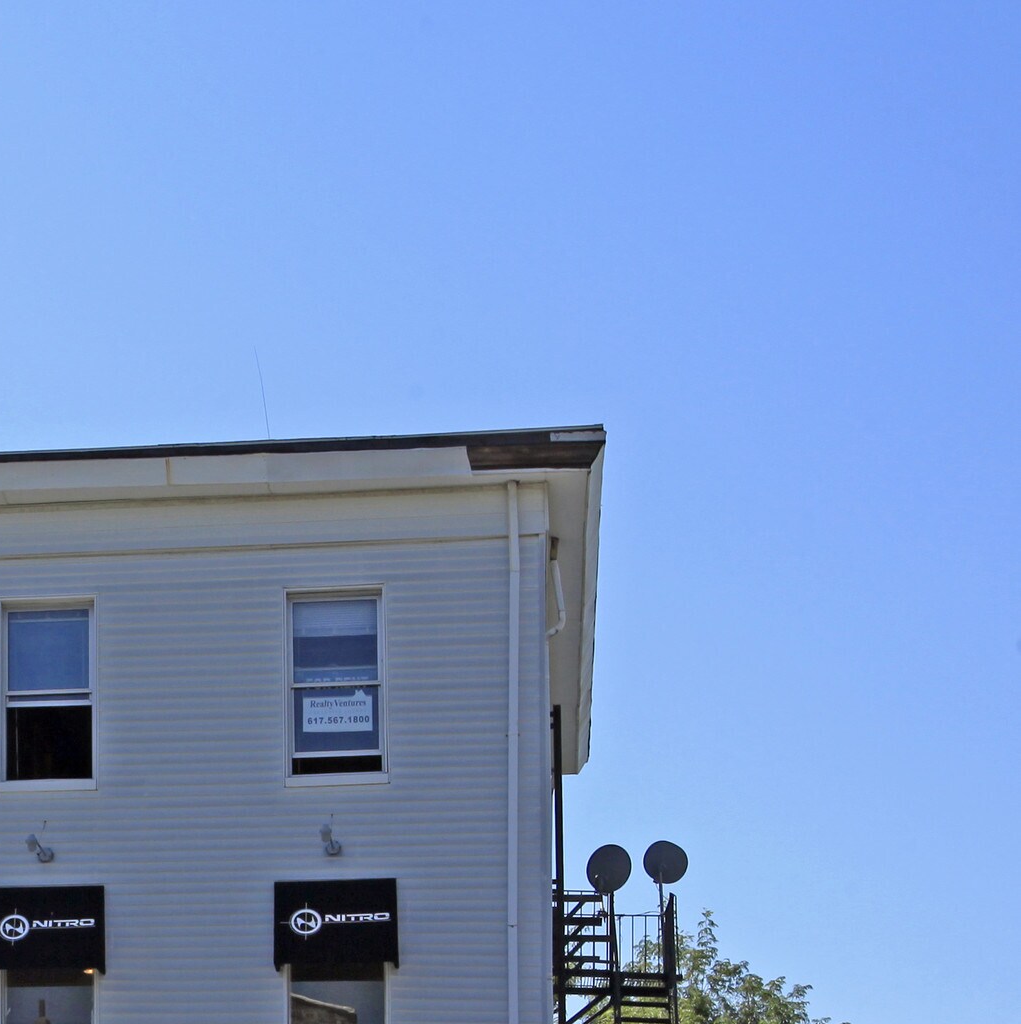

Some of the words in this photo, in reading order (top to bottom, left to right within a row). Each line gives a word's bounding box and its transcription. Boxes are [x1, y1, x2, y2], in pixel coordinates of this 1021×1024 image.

[308, 715, 369, 724] 617.567.1800
[324, 912, 390, 922] NITRO
[32, 918, 95, 928] NITRO
